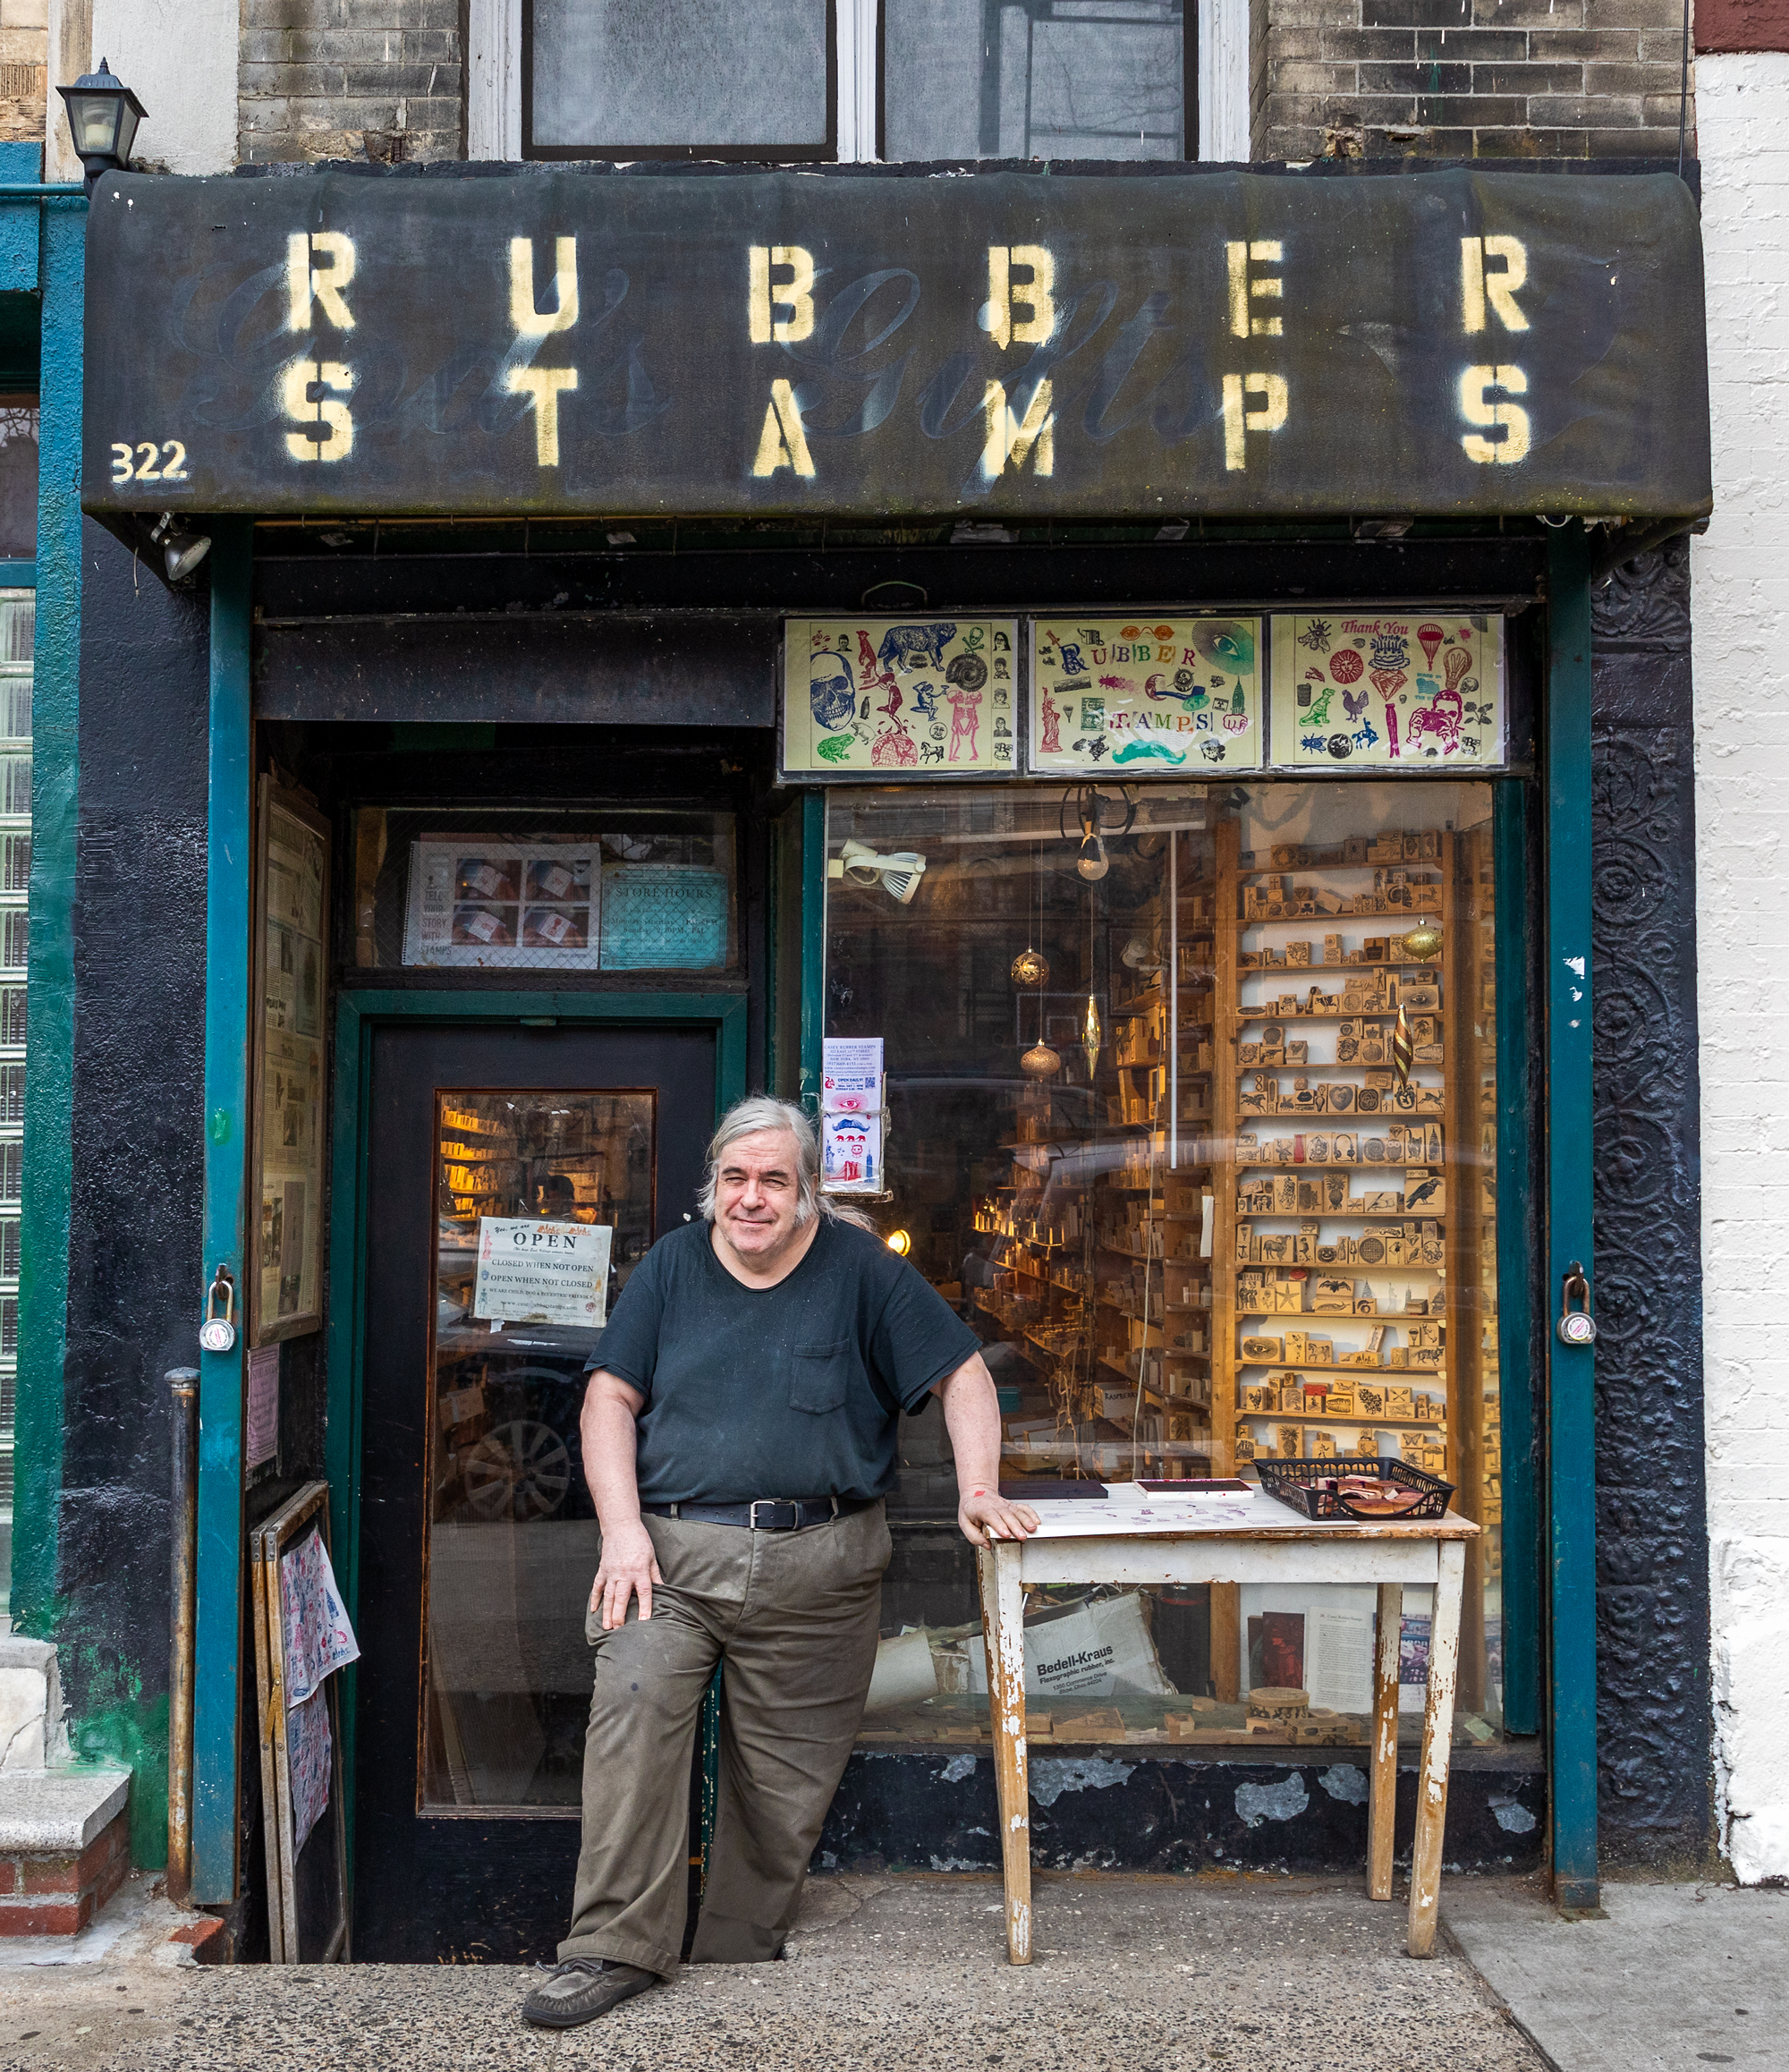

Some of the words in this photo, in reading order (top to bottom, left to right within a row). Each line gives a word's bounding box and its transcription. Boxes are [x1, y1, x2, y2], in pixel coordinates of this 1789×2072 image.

[286, 231, 1530, 346] RUBBER
[283, 361, 1530, 478] STAMPS
[111, 440, 188, 483] 322
[1341, 619, 1383, 637] Thank
[1384, 621, 1408, 634] You
[1059, 642, 1197, 676] RUBBER
[425, 891, 443, 901] TELL
[616, 887, 662, 897] STORE
[665, 887, 712, 898] HOURS
[422, 918, 447, 928] STORY
[420, 945, 452, 955] STAMPS
[513, 1232, 577, 1249] OPEN
[492, 1259, 524, 1267] CLOSED
[525, 1261, 551, 1269] WHEN
[571, 1264, 594, 1272] OPEN
[515, 1276, 541, 1284] WHEN
[561, 1279, 593, 1288] CLOSED
[1036, 1645, 1113, 1676] Bedell-Kraus
[1039, 1668, 1080, 1684] Flexographic
[1081, 1662, 1104, 1672] rubber,
[1066, 1675, 1093, 1687] Commerce
